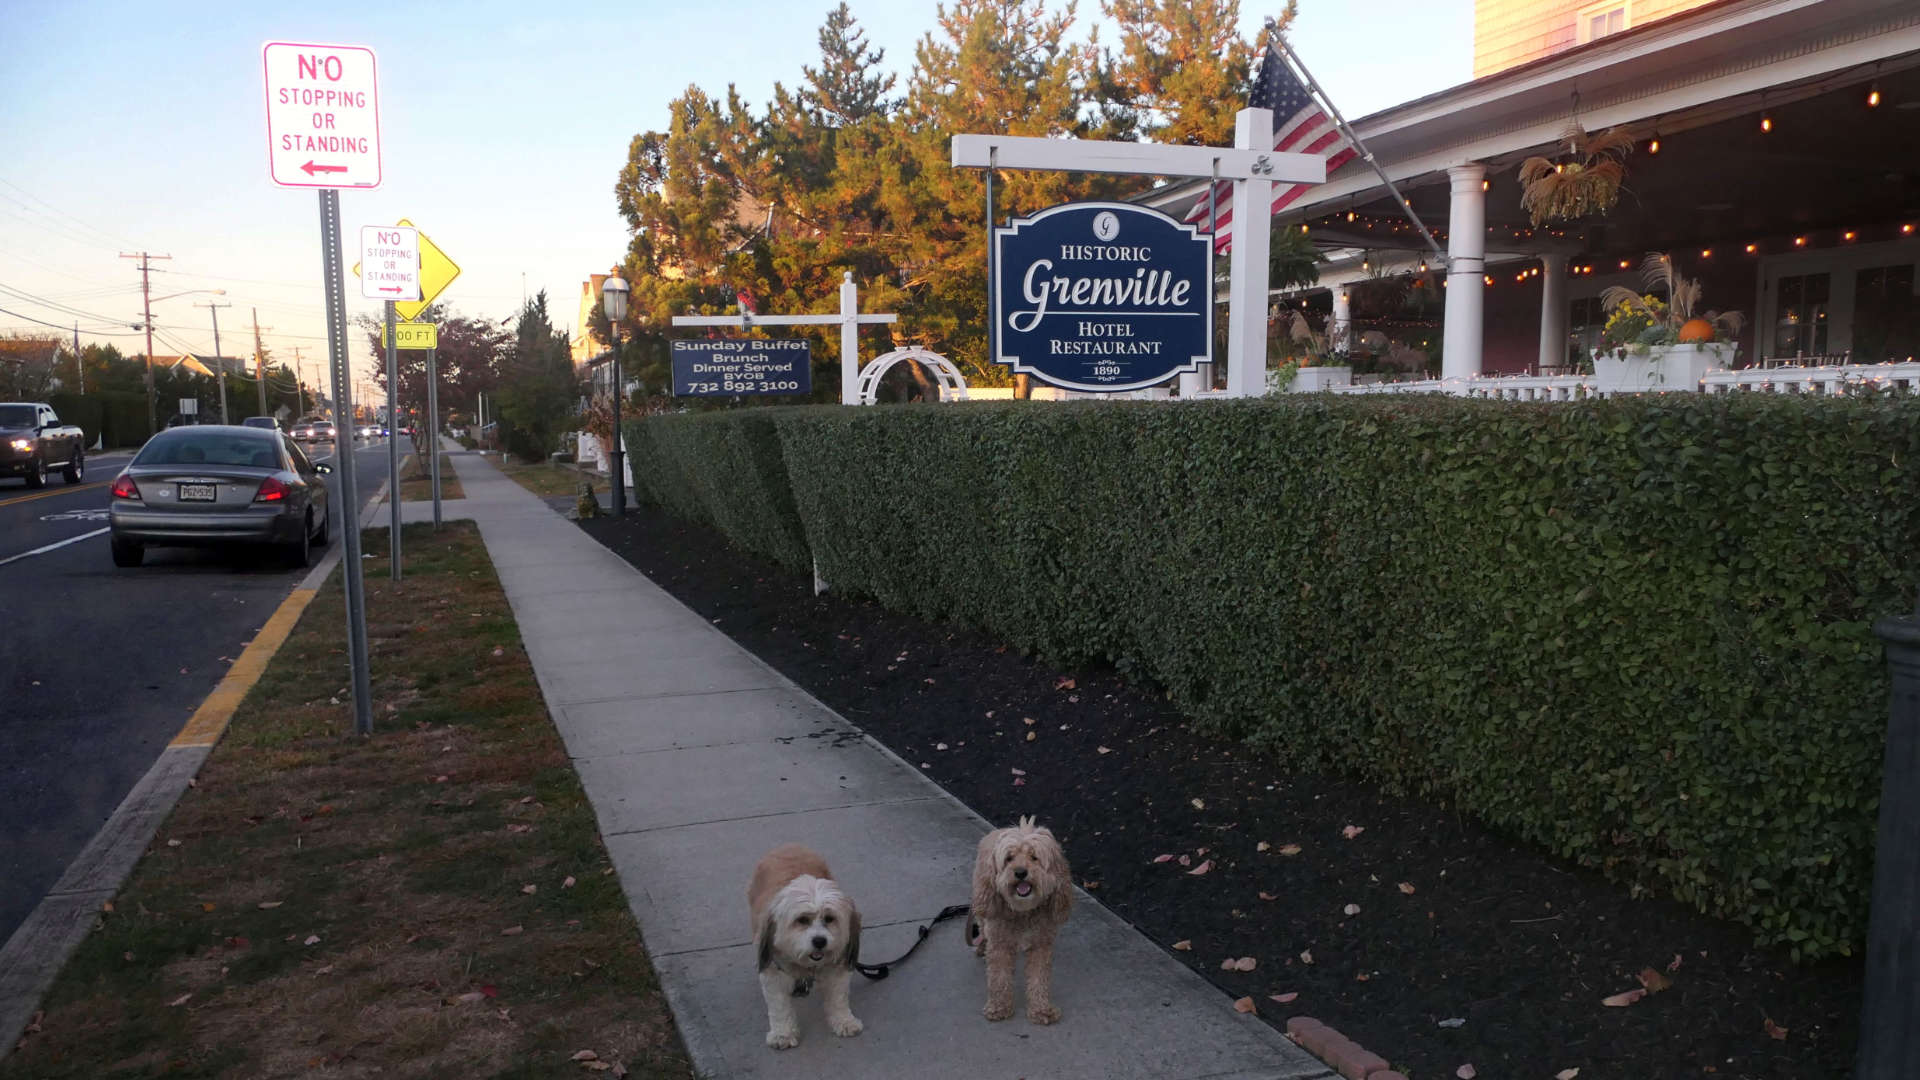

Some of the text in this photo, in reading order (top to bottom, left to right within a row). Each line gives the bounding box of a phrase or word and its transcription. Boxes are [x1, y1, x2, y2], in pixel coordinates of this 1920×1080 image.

[298, 54, 342, 81] NO
[280, 87, 366, 108] STOPPING
[313, 112, 335, 129] OR
[282, 134, 368, 153] STANDING
[377, 231, 401, 245] NO
[367, 248, 412, 259] STOPPING
[1061, 245, 1152, 262] HISTORIC
[384, 261, 396, 270] OR
[367, 272, 412, 282] STANDING
[1008, 259, 1192, 332] Grenville
[394, 331, 431, 341] 00 FT
[674, 340, 808, 352] Sunday Buffet
[713, 353, 769, 363] Brunch
[693, 363, 792, 373] Dinner Served
[1093, 366, 1121, 376] 1890
[687, 380, 798, 393] 732 892 3100
